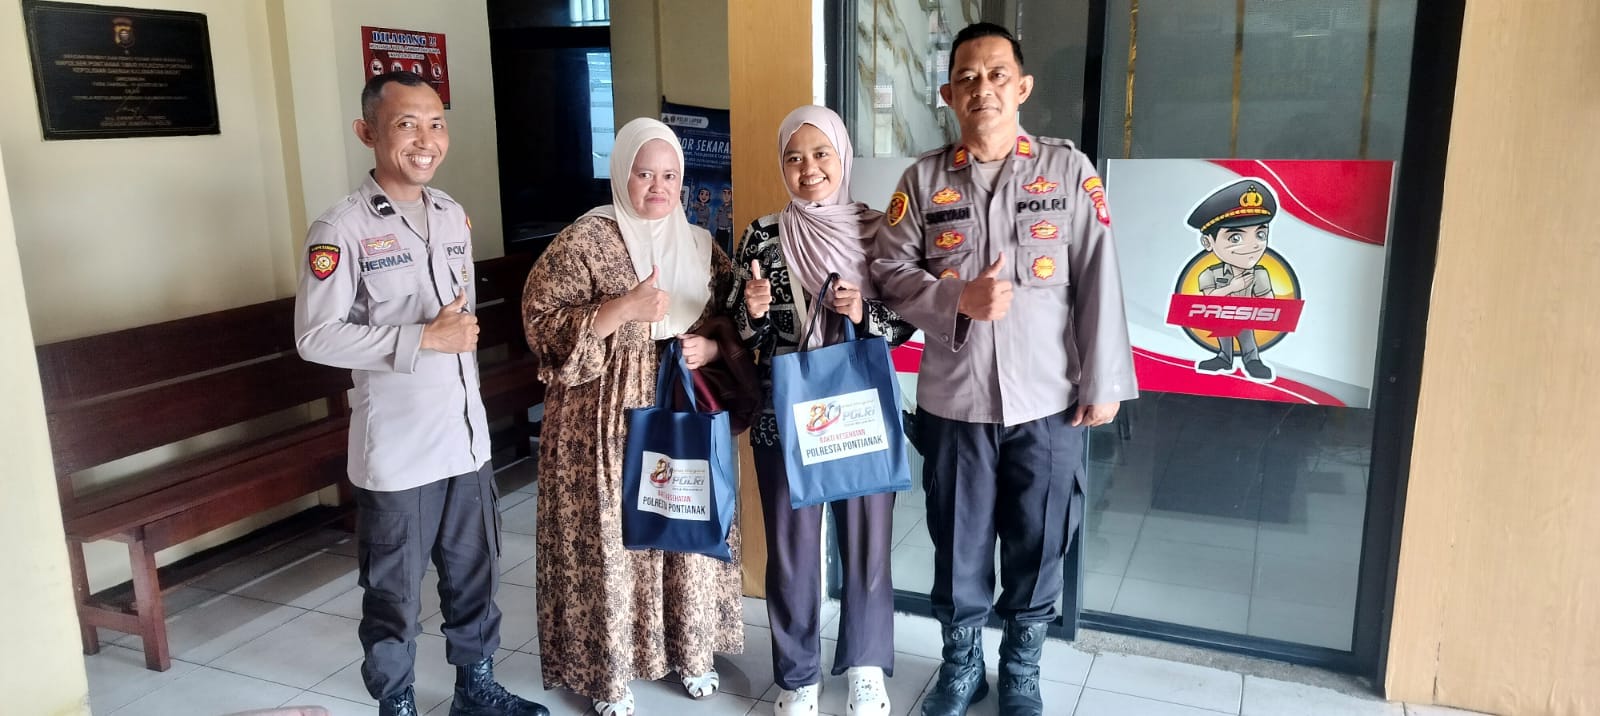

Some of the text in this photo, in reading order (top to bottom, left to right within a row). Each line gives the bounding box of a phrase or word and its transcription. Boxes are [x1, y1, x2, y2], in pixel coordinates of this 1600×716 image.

[371, 30, 427, 46] DILARANG
[696, 139, 730, 154] SEKARA
[1017, 198, 1067, 214] POLRI
[359, 252, 414, 272] HERMAN
[1188, 303, 1281, 322] PRESISI
[806, 434, 884, 458] POLRESTA PONTIANAK
[672, 475, 705, 485] POLRI
[668, 503, 706, 515] PONTIANAK
